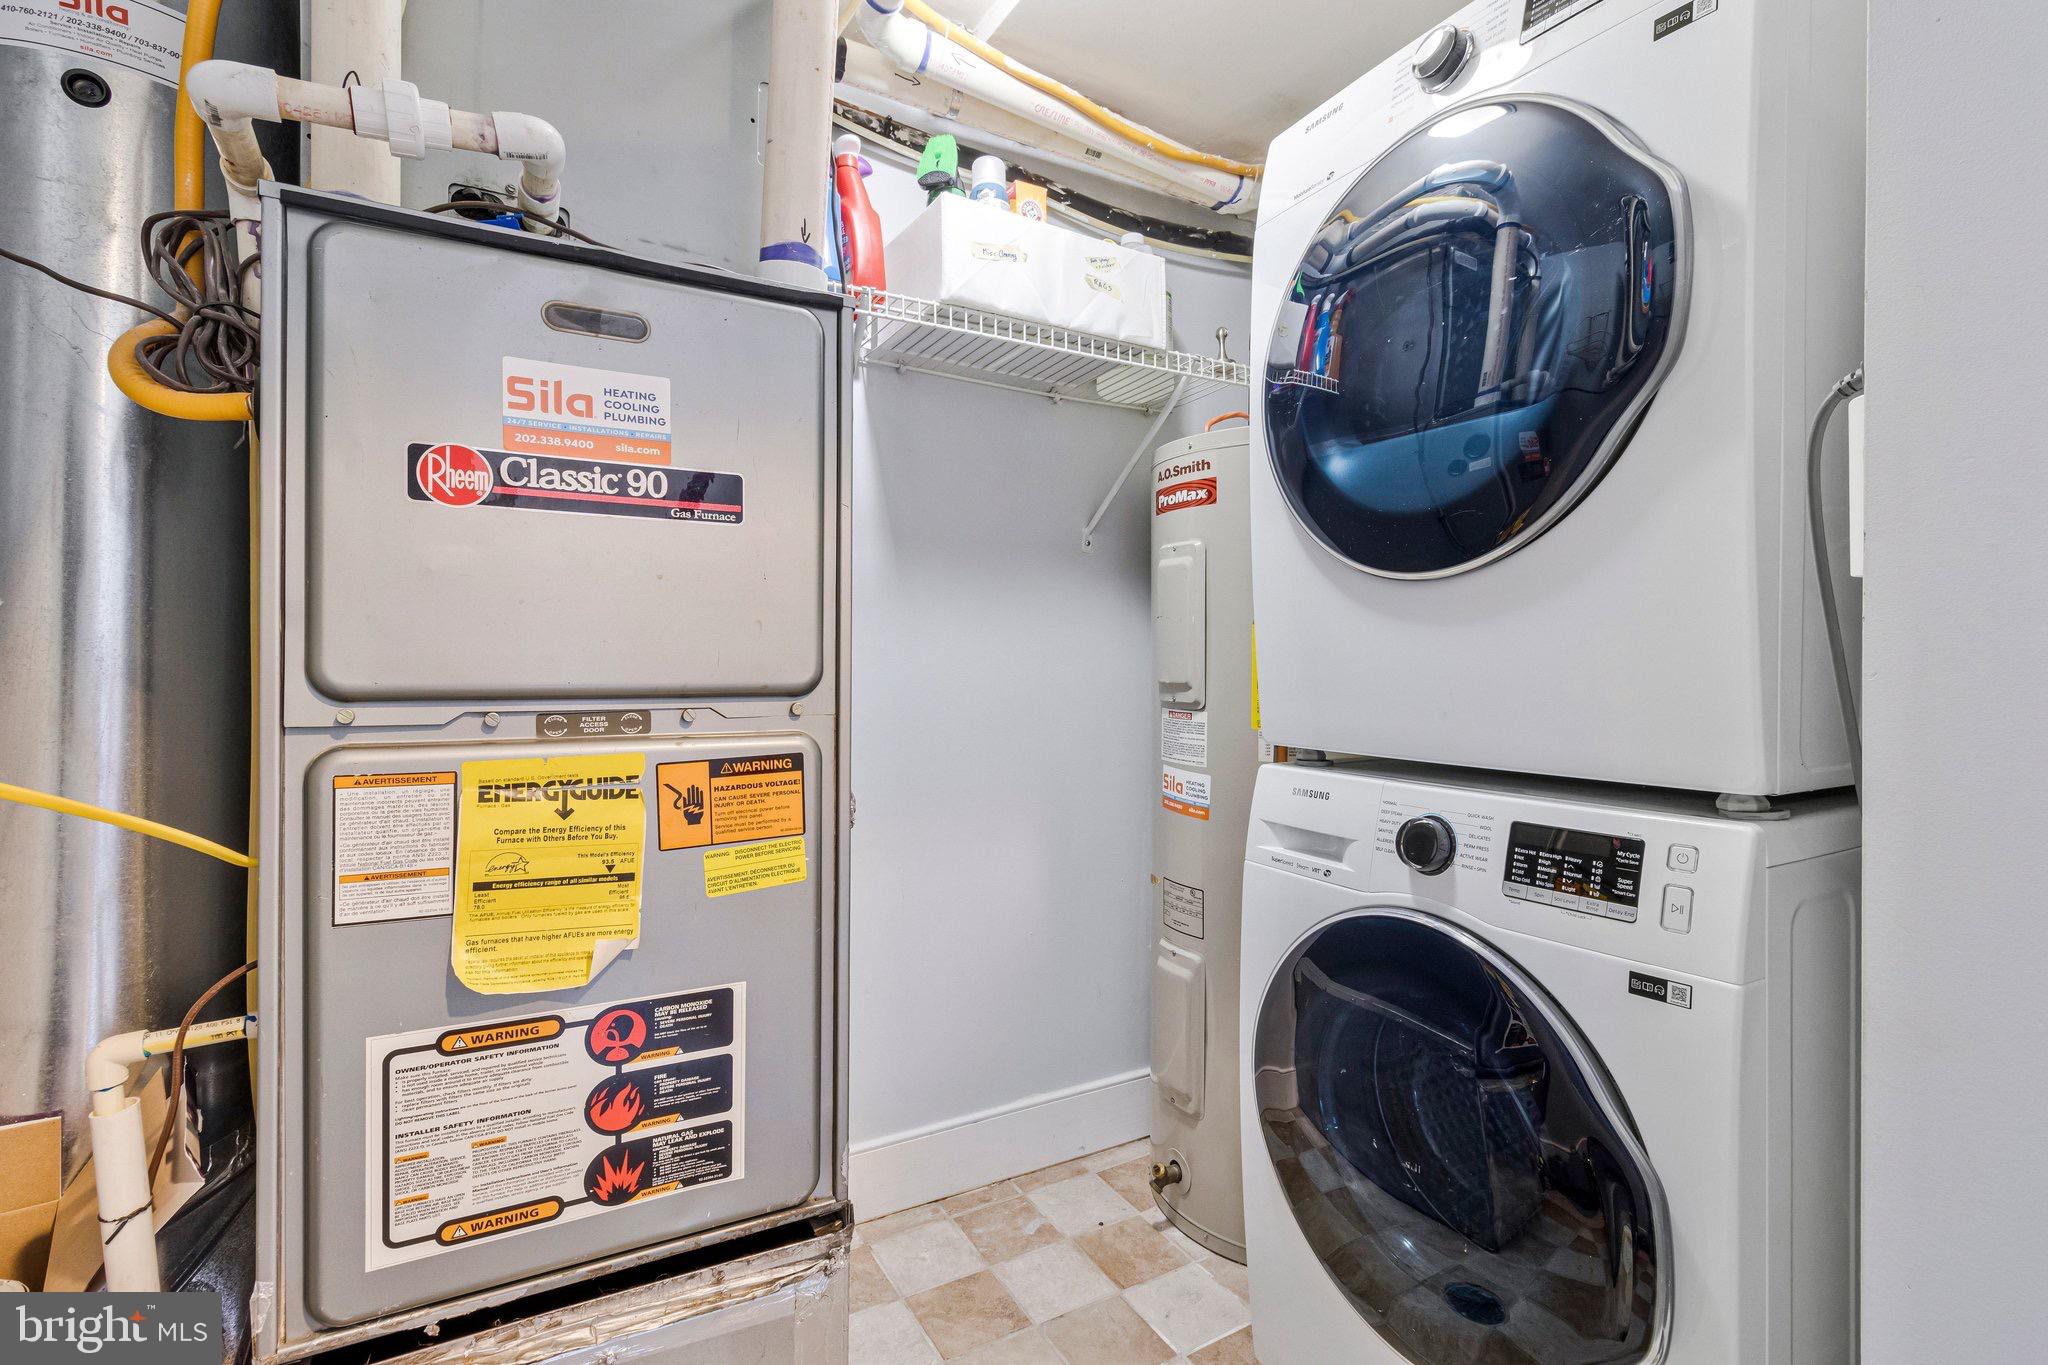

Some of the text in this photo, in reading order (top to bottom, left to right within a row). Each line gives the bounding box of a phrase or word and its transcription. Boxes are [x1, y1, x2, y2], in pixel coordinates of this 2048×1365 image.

[1, 4, 58, 20] 410-760-2121
[66, 16, 126, 39] 202-338-9400
[134, 36, 182, 59] 703-837-00
[80, 45, 113, 58] sila.com
[1305, 103, 1344, 134] SAMSUNG
[507, 375, 594, 419] Sila
[604, 388, 656, 402] HEATING
[604, 400, 660, 414] COOLING
[604, 412, 667, 427] PLUMBING
[528, 420, 562, 429] SERVICE
[569, 424, 629, 437] INSTALLATIONS
[635, 432, 667, 440] REPAIRS
[515, 433, 661, 456] 202.338.9400 sila.com
[428, 445, 489, 496] Rheem
[500, 456, 668, 499] Classic 90
[1159, 489, 1207, 508] ProMax
[671, 508, 736, 522] Gas Furnace
[733, 759, 792, 773] WARNING
[363, 776, 437, 786] AVERTISSEMENT
[714, 779, 801, 792] HAZARDOUS VOLTAGE!
[1164, 774, 1183, 795] Sila
[478, 775, 640, 803] ENERGYGUIDE
[1186, 786, 1206, 794] COOLING
[1292, 787, 1331, 801] SAMSUNG
[494, 827, 527, 837] Compare
[543, 826, 567, 836] Energy
[569, 825, 603, 835] Efficiency
[605, 824, 612, 832] of
[497, 836, 525, 844] Furnace
[543, 834, 566, 843] Others
[604, 833, 619, 842] Buy.
[1469, 834, 1491, 842] DELICATES
[735, 845, 768, 855] DISCONNECT
[779, 840, 802, 848] ELECTRIC
[735, 846, 801, 861] POWER BEFORE SERVICING
[1627, 852, 1640, 860] Cycle
[371, 871, 426, 881] AVERTISSEMENT
[707, 881, 728, 889] CIRCUIT
[729, 873, 770, 885] D'ALIMENTATION
[493, 881, 512, 890] Energy
[514, 880, 543, 889] efficiency
[545, 879, 562, 887] range
[1609, 908, 1624, 916] Delay
[542, 934, 562, 942] higher
[614, 929, 634, 937] energy
[465, 946, 498, 954] efficient.
[655, 999, 713, 1013] CARBON MONOXIDE
[679, 1005, 708, 1013] RELEASED
[471, 1026, 540, 1045] WARNING
[395, 1043, 560, 1075] OWNER/OPERATOR SAFETY INFORMATION
[641, 1051, 671, 1060] WARNING
[395, 1109, 532, 1140] INSTALLER SAFETY INFORMATION
[642, 1117, 671, 1128] WARNING
[480, 1139, 504, 1147] WARNING
[653, 1133, 679, 1142] NATURAL
[668, 1137, 683, 1145] LEAK
[699, 1128, 725, 1138] EXPLODE
[641, 1185, 671, 1198] WARNING
[471, 1208, 540, 1232] WARNING
